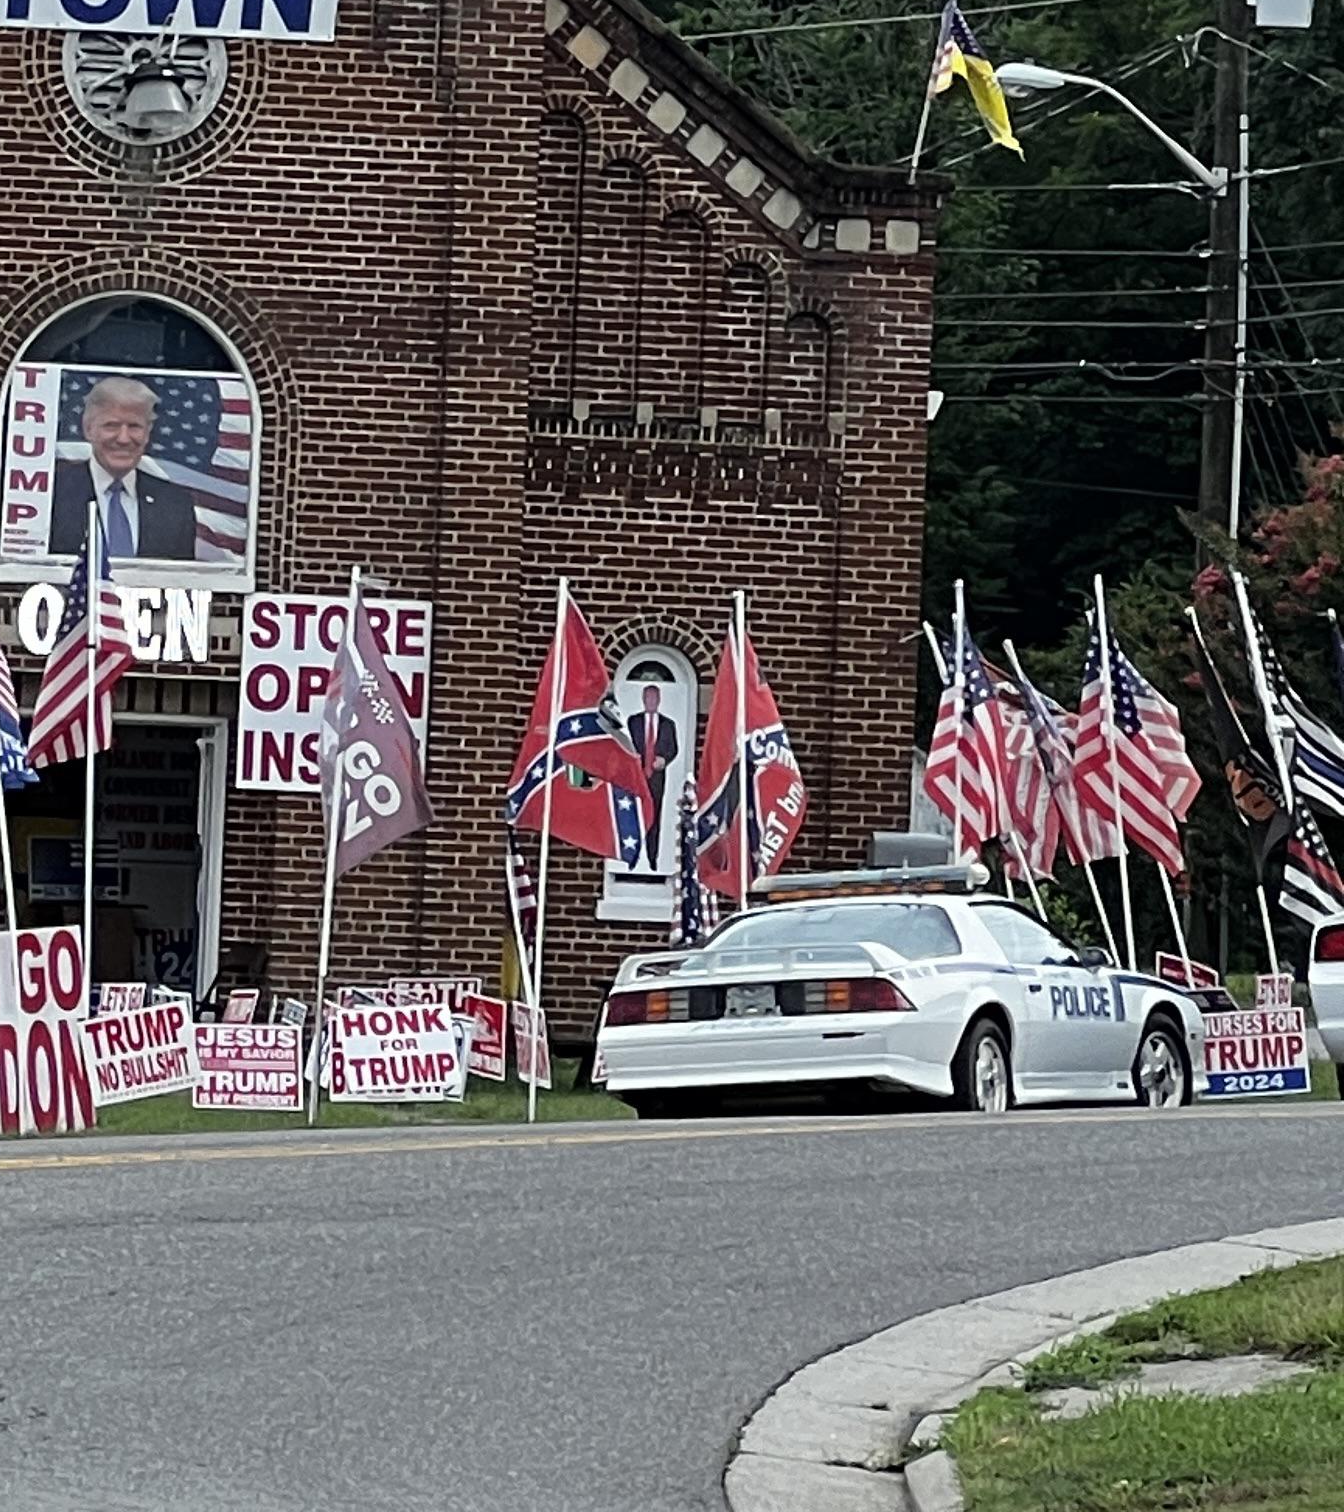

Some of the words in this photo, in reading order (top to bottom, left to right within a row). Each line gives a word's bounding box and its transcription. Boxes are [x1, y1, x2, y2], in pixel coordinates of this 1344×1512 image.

[6, 366, 49, 525] TRUMP
[18, 582, 213, 664] OEN
[249, 600, 426, 657] STORE
[245, 663, 425, 719] OPN
[16, 929, 84, 1014] GO
[1051, 985, 1111, 1021] POLICE
[85, 1005, 185, 1060] TRUMP
[197, 1028, 297, 1048] JESUS
[341, 1007, 449, 1038] HONK
[1267, 1010, 1298, 1034] FOR
[215, 1047, 239, 1059] MY
[241, 1048, 295, 1061] SAVIOR
[379, 1037, 419, 1051] FOR
[1204, 1035, 1304, 1072] TRUMP
[95, 1061, 119, 1094] NO
[120, 1046, 189, 1089] BULLSHIT
[200, 1071, 298, 1094] TRUMP
[348, 1052, 455, 1087] TRUMP
[1223, 1073, 1285, 1092] 2024
